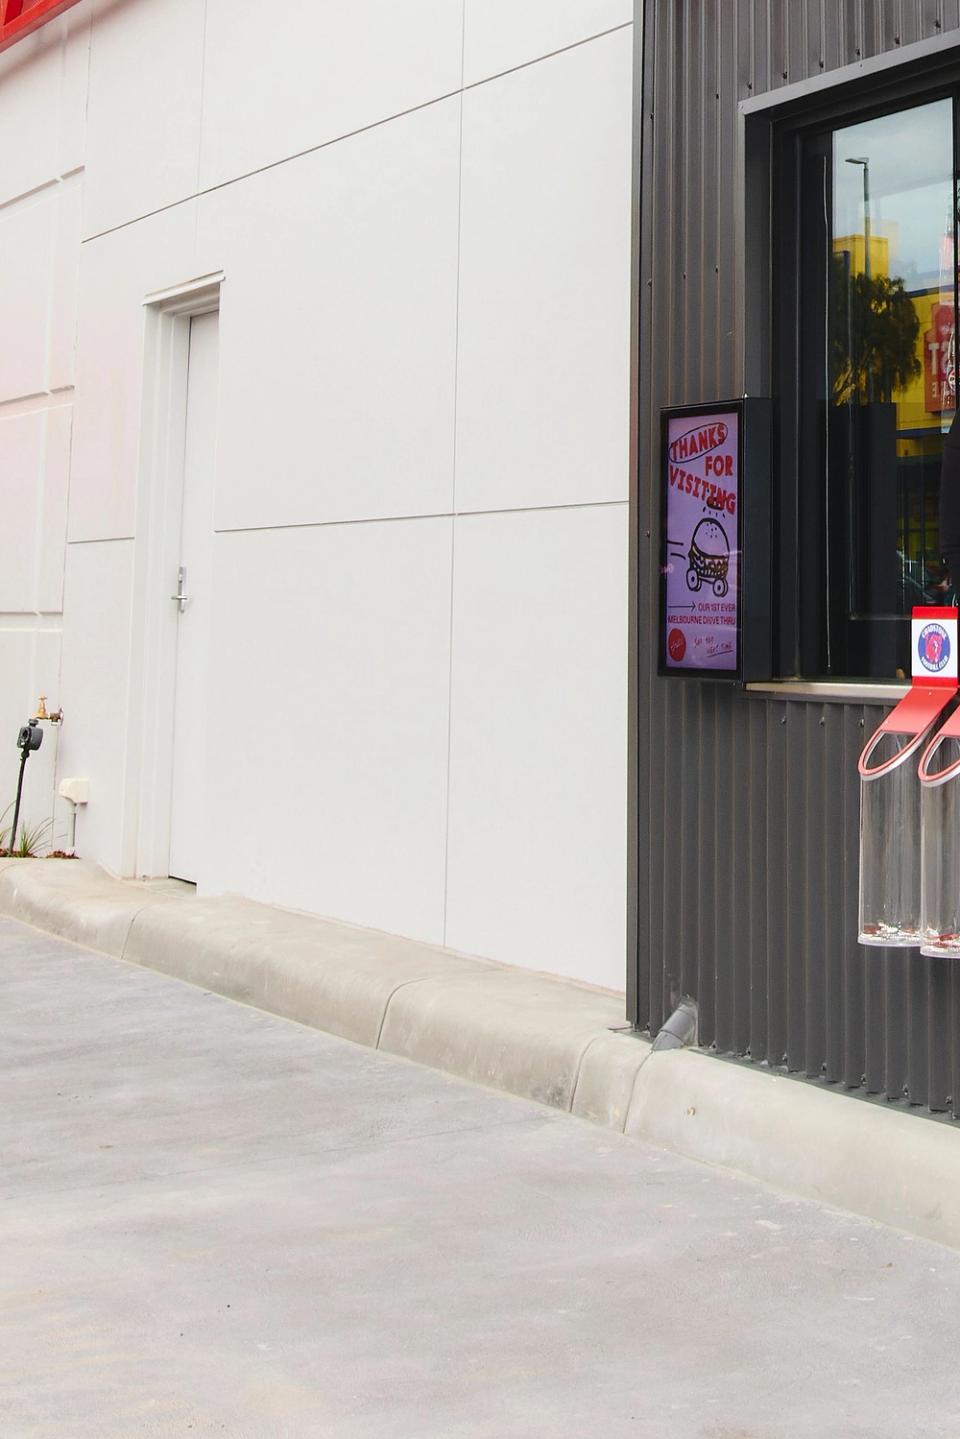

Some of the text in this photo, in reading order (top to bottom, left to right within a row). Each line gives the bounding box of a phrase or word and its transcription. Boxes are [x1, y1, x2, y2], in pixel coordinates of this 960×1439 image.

[671, 423, 725, 461] THANKS
[704, 455, 734, 477] FOR
[669, 464, 737, 515] VISITING
[698, 602, 710, 612] OUR
[720, 602, 736, 612] EVER
[667, 615, 736, 625] MELBOURNE DRIVE THRU
